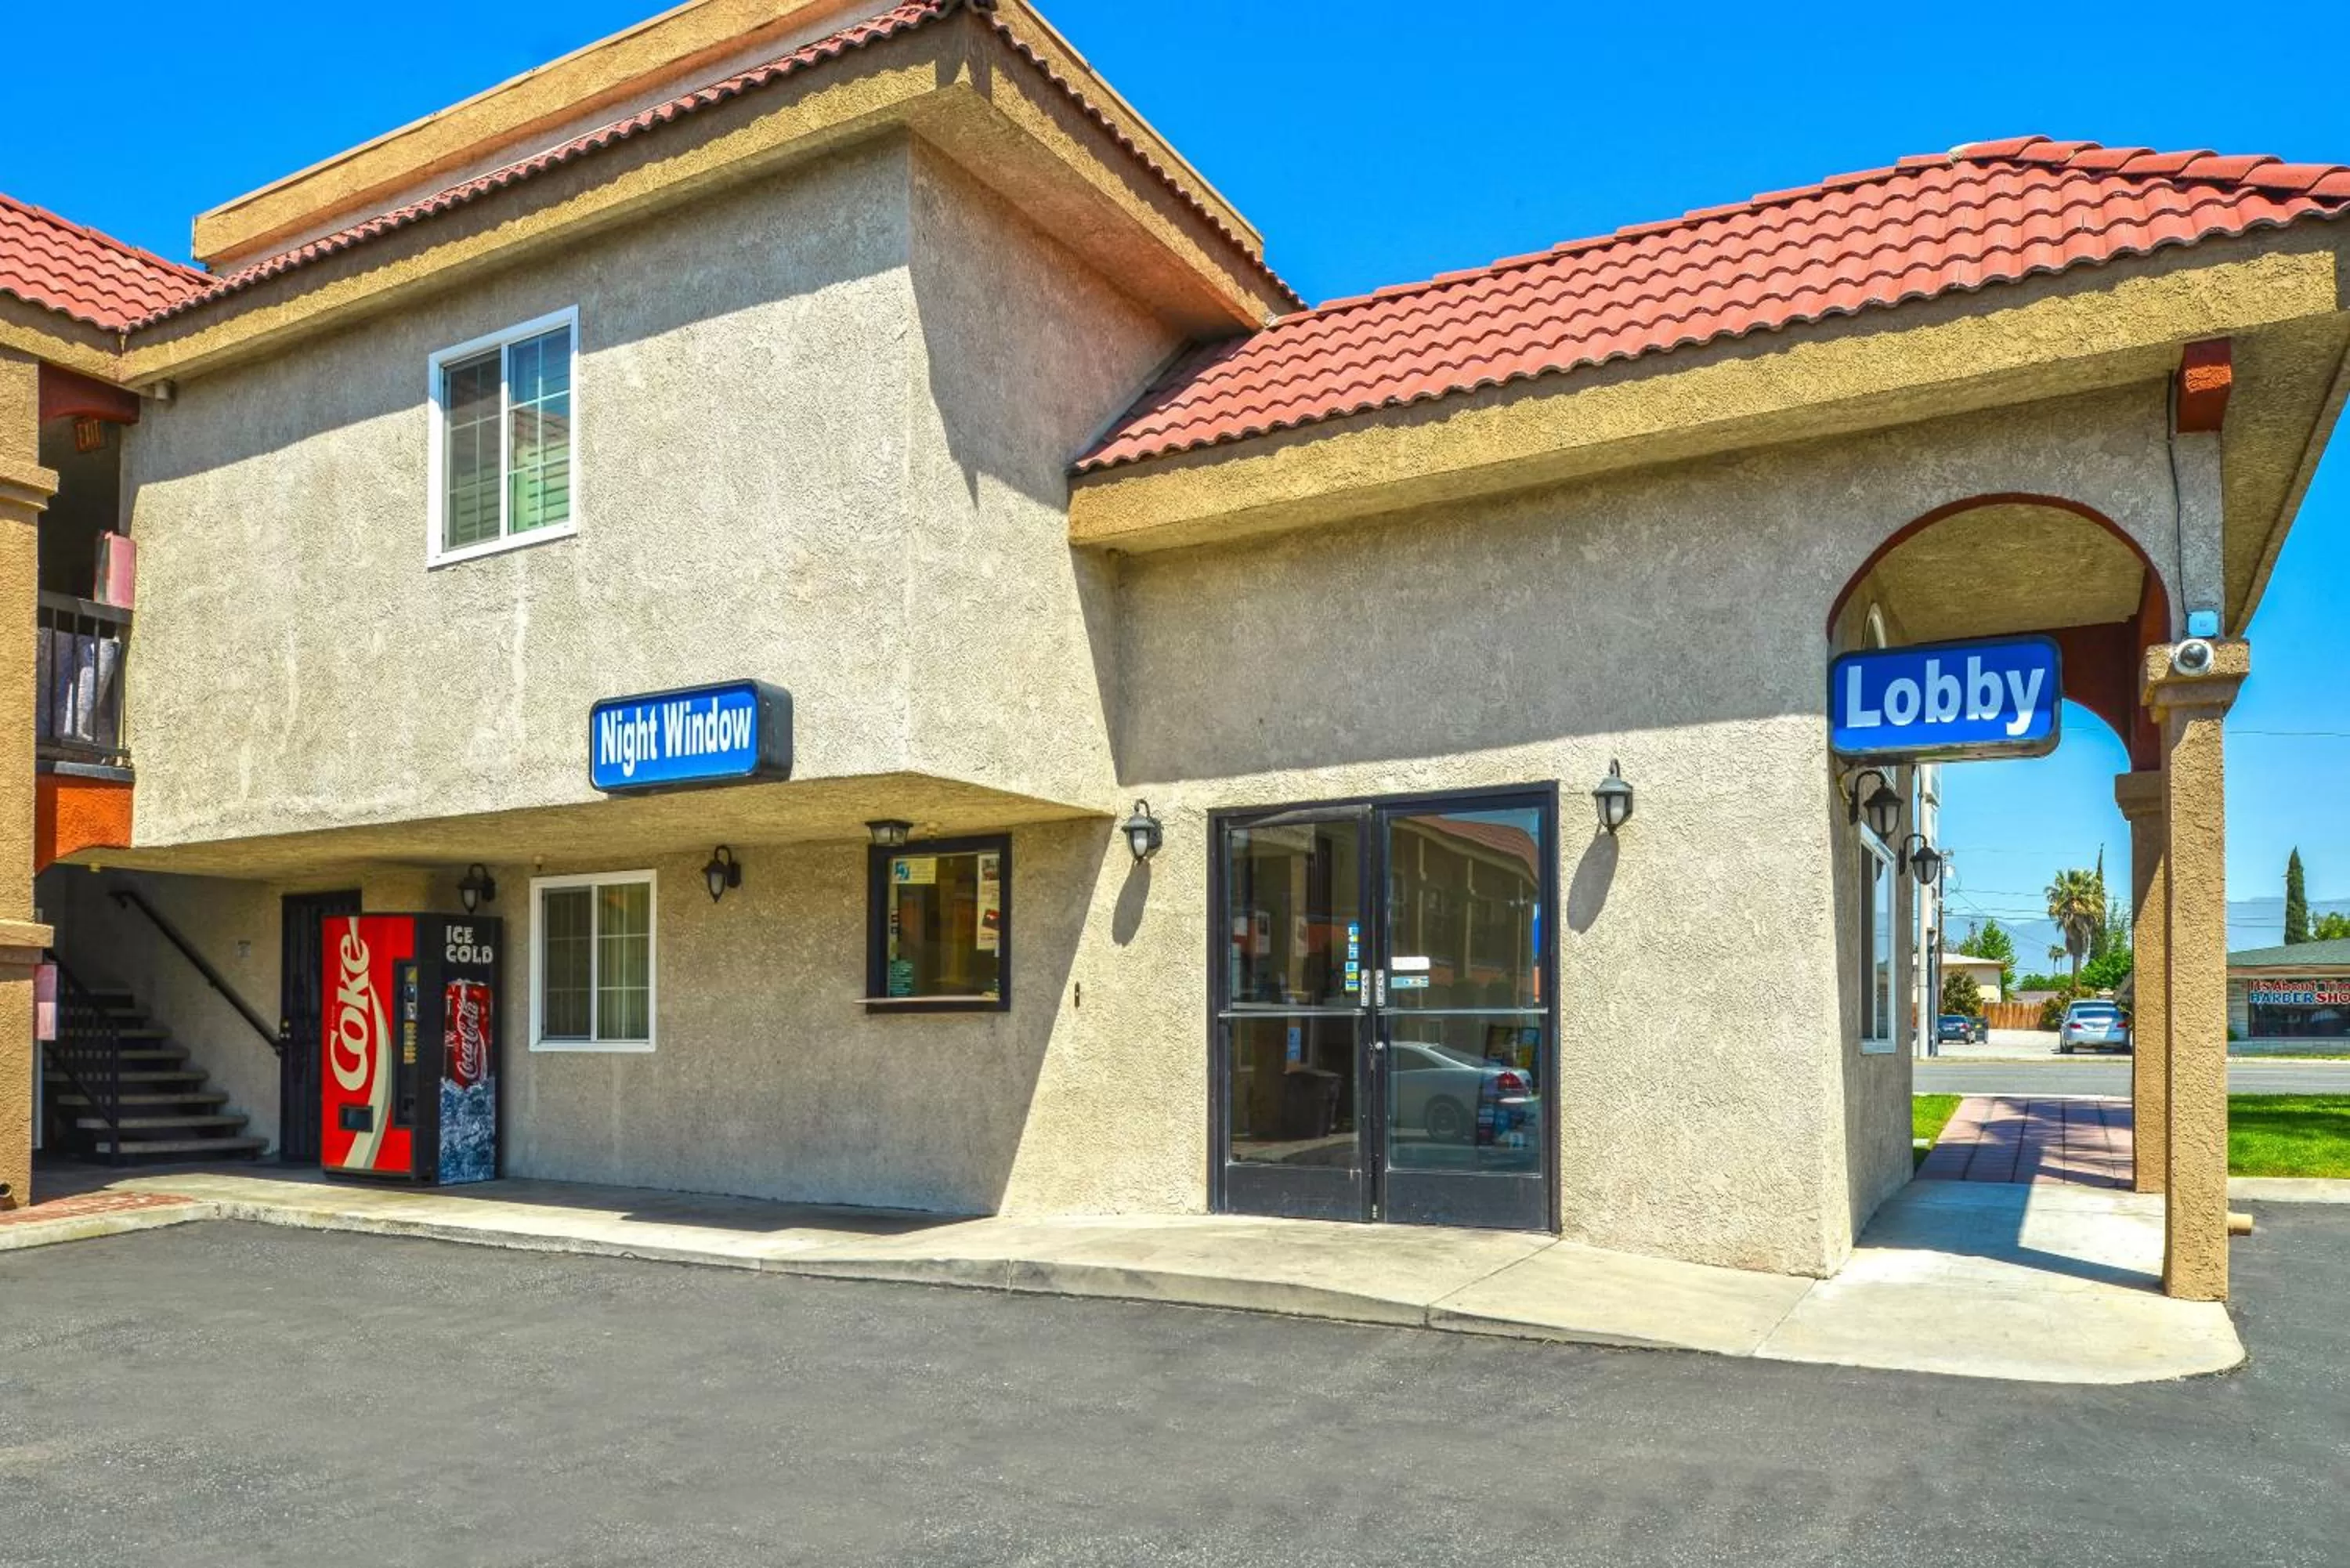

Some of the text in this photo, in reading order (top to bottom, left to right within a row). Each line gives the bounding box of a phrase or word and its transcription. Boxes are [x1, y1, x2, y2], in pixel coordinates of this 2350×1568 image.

[1846, 656, 2046, 736] Lobby
[600, 696, 753, 778] Night Window
[445, 925, 474, 945] ICE
[446, 945, 494, 965] COLD
[330, 933, 371, 1091] Coke
[2250, 992, 2315, 1004] BARBER
